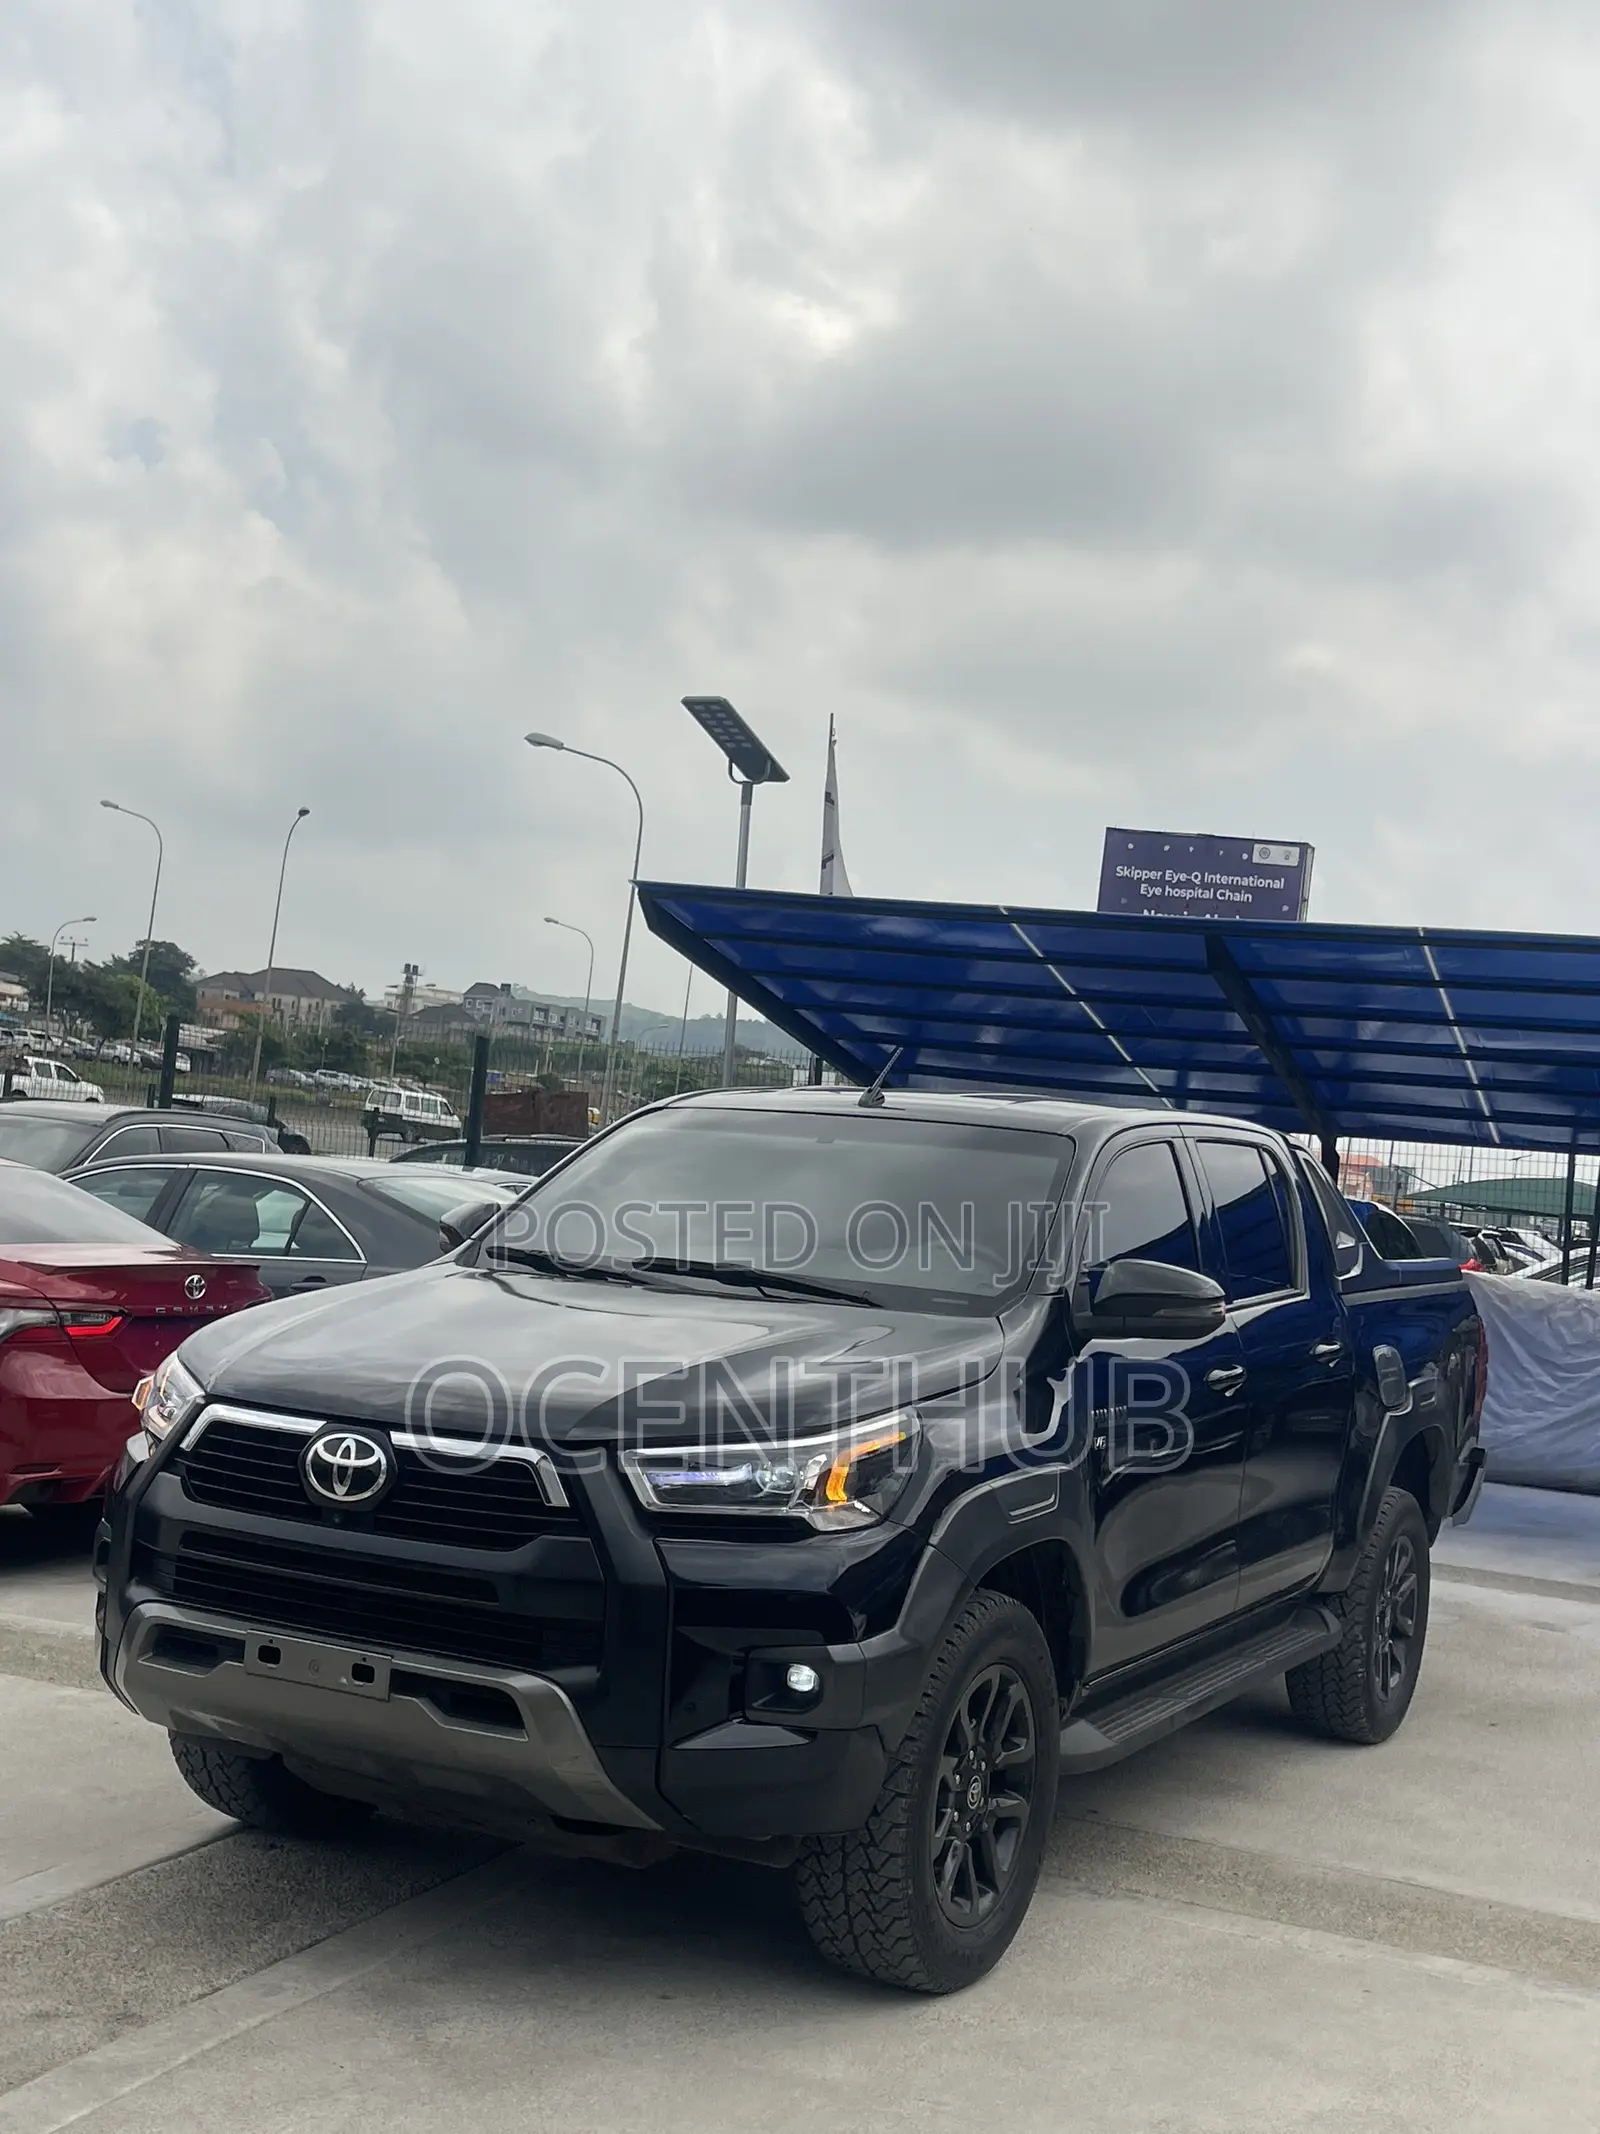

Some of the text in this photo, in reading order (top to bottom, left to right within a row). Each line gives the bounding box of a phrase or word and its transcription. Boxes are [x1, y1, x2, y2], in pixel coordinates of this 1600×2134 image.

[1115, 865, 1286, 890] Skipper Eye-Q International
[1140, 883, 1253, 903] Eye hospital Chain
